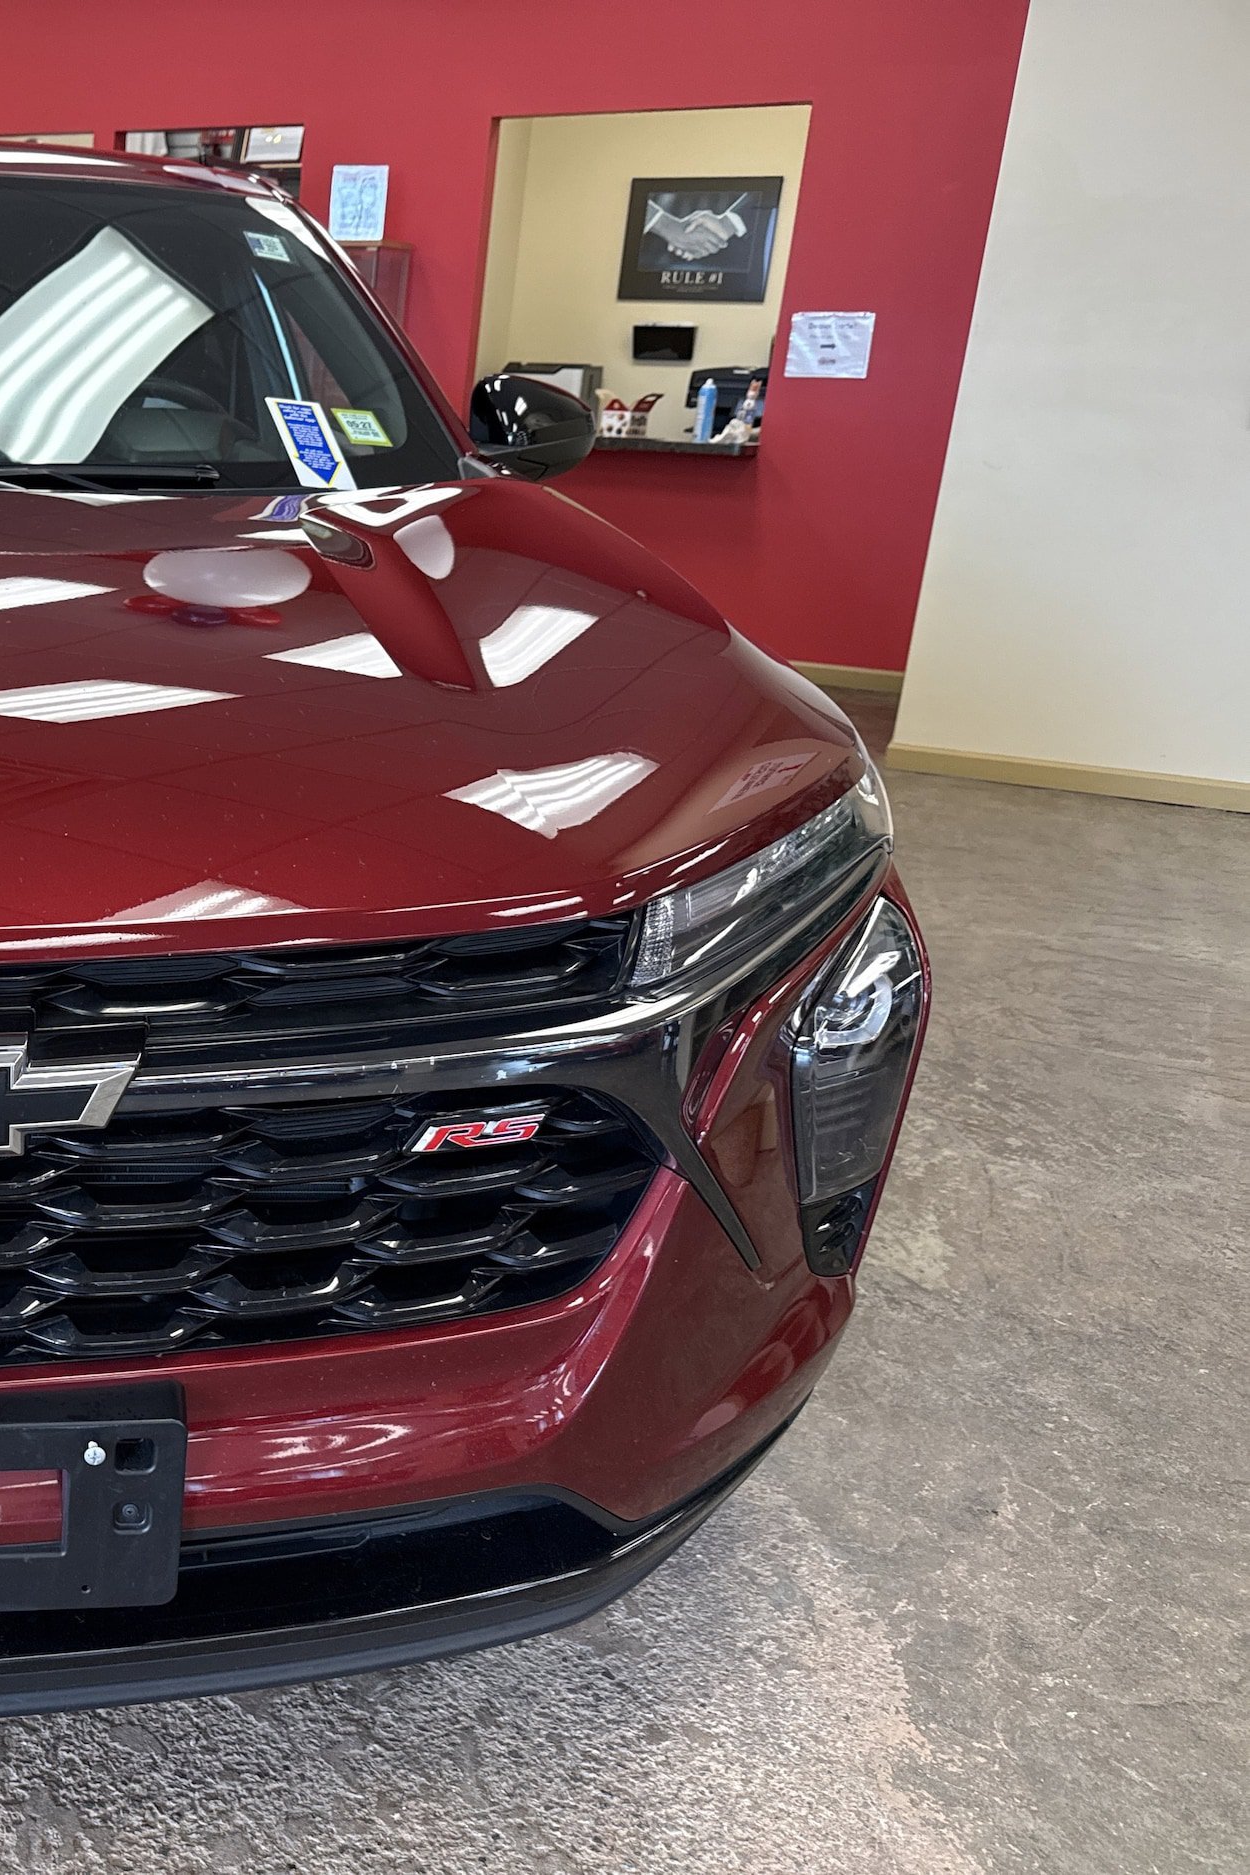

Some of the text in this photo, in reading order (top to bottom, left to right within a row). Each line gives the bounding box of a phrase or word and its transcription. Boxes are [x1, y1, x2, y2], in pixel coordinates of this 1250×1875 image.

[660, 271, 723, 284] RULE #1
[414, 1113, 546, 1153] RS
